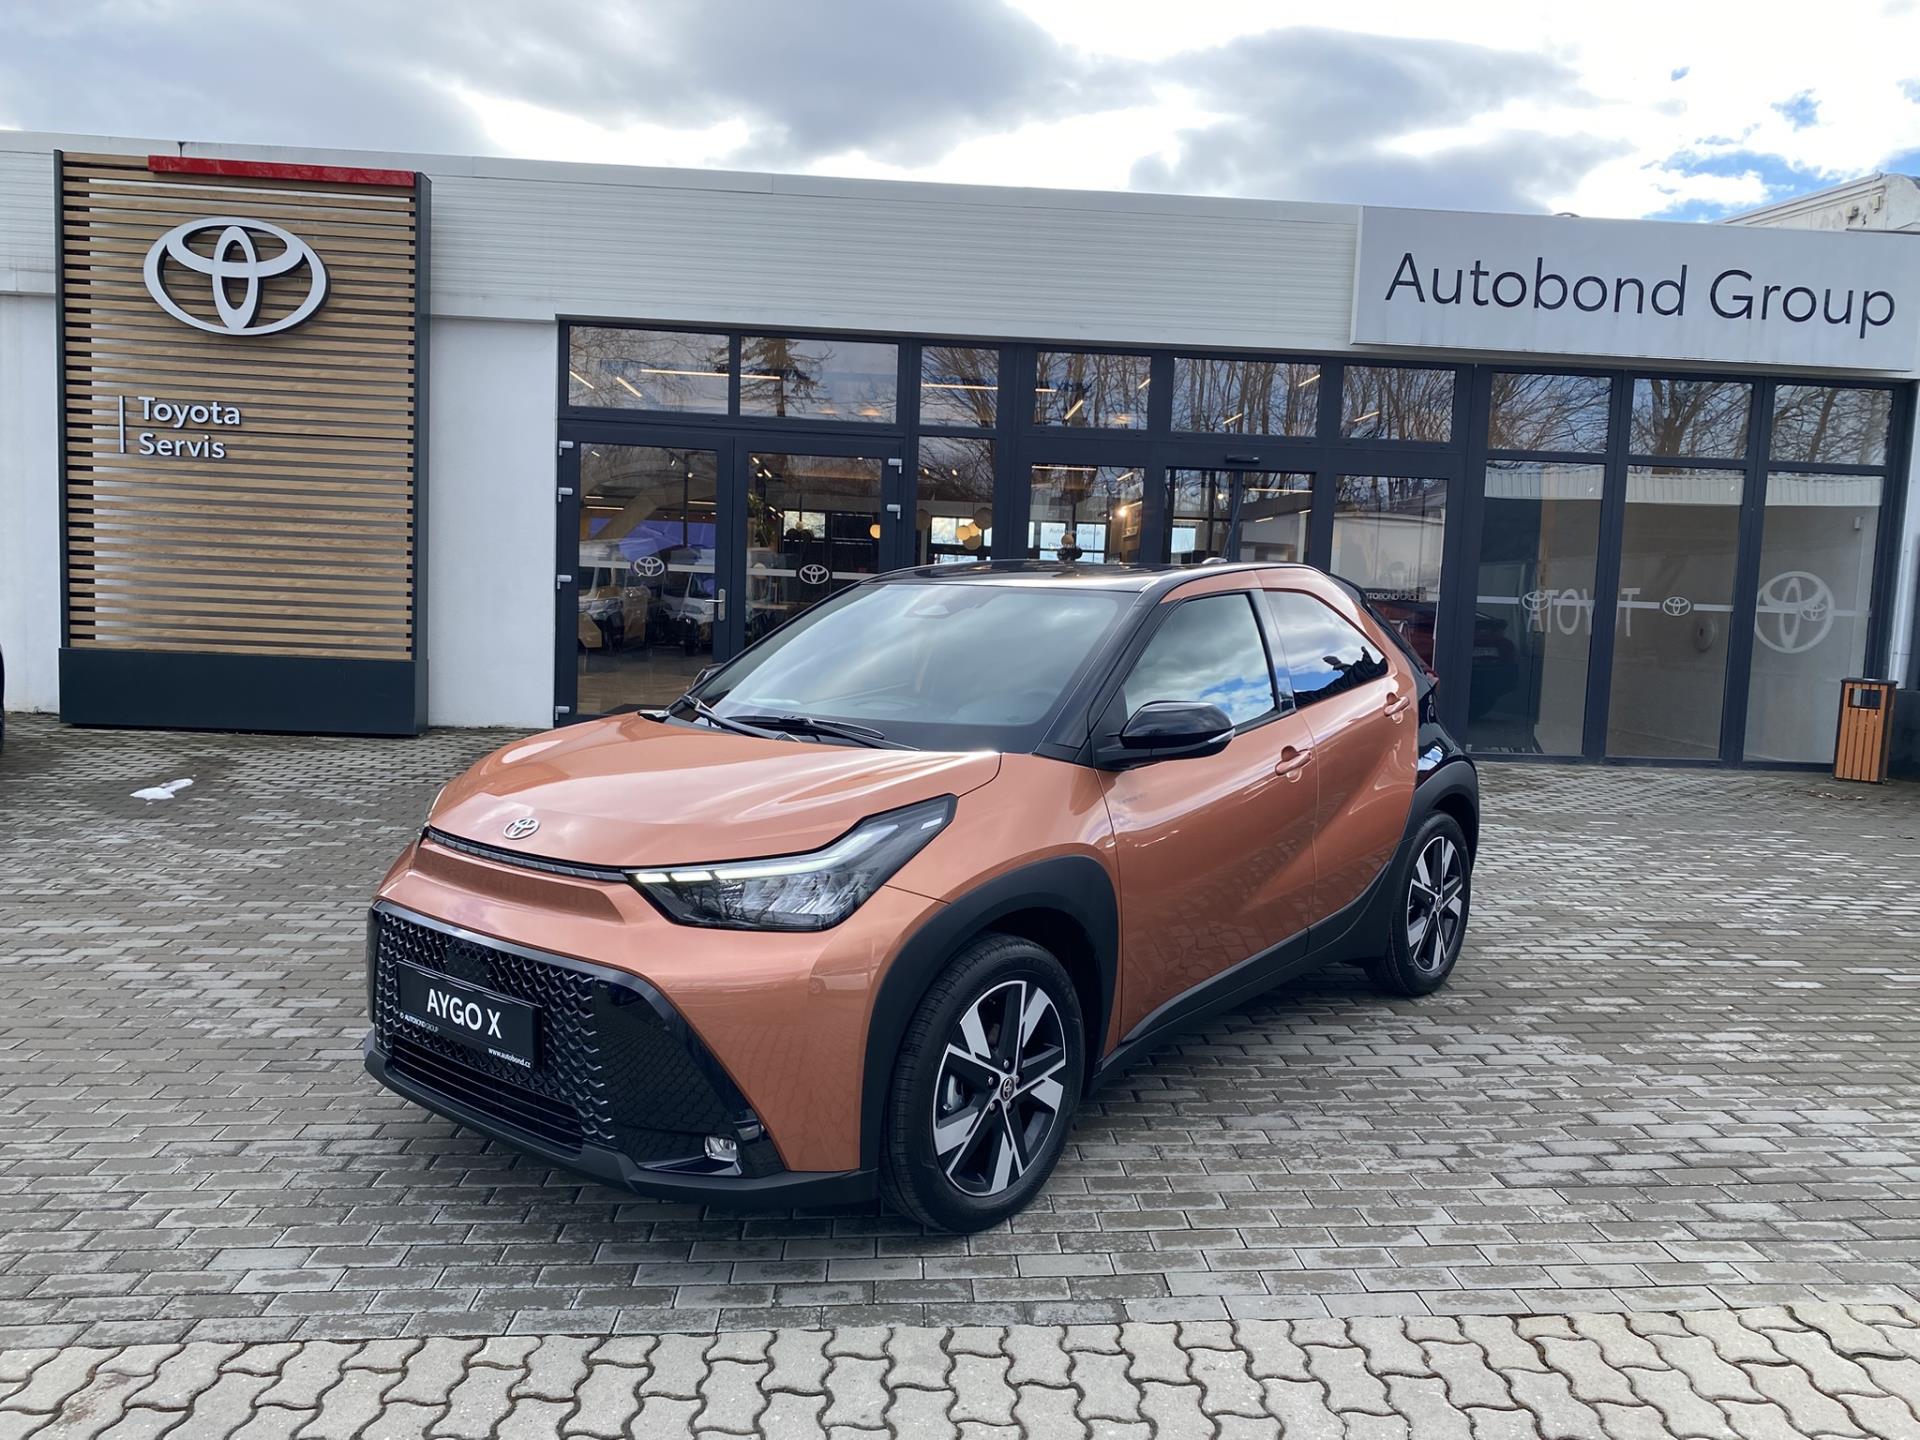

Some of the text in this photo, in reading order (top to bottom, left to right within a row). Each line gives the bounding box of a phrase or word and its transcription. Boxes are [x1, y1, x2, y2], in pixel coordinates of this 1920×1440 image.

[1385, 252, 1896, 339] Autobond Group
[137, 395, 241, 428] Toyota
[139, 432, 226, 459] Servis
[427, 988, 502, 1039] AYGO X
